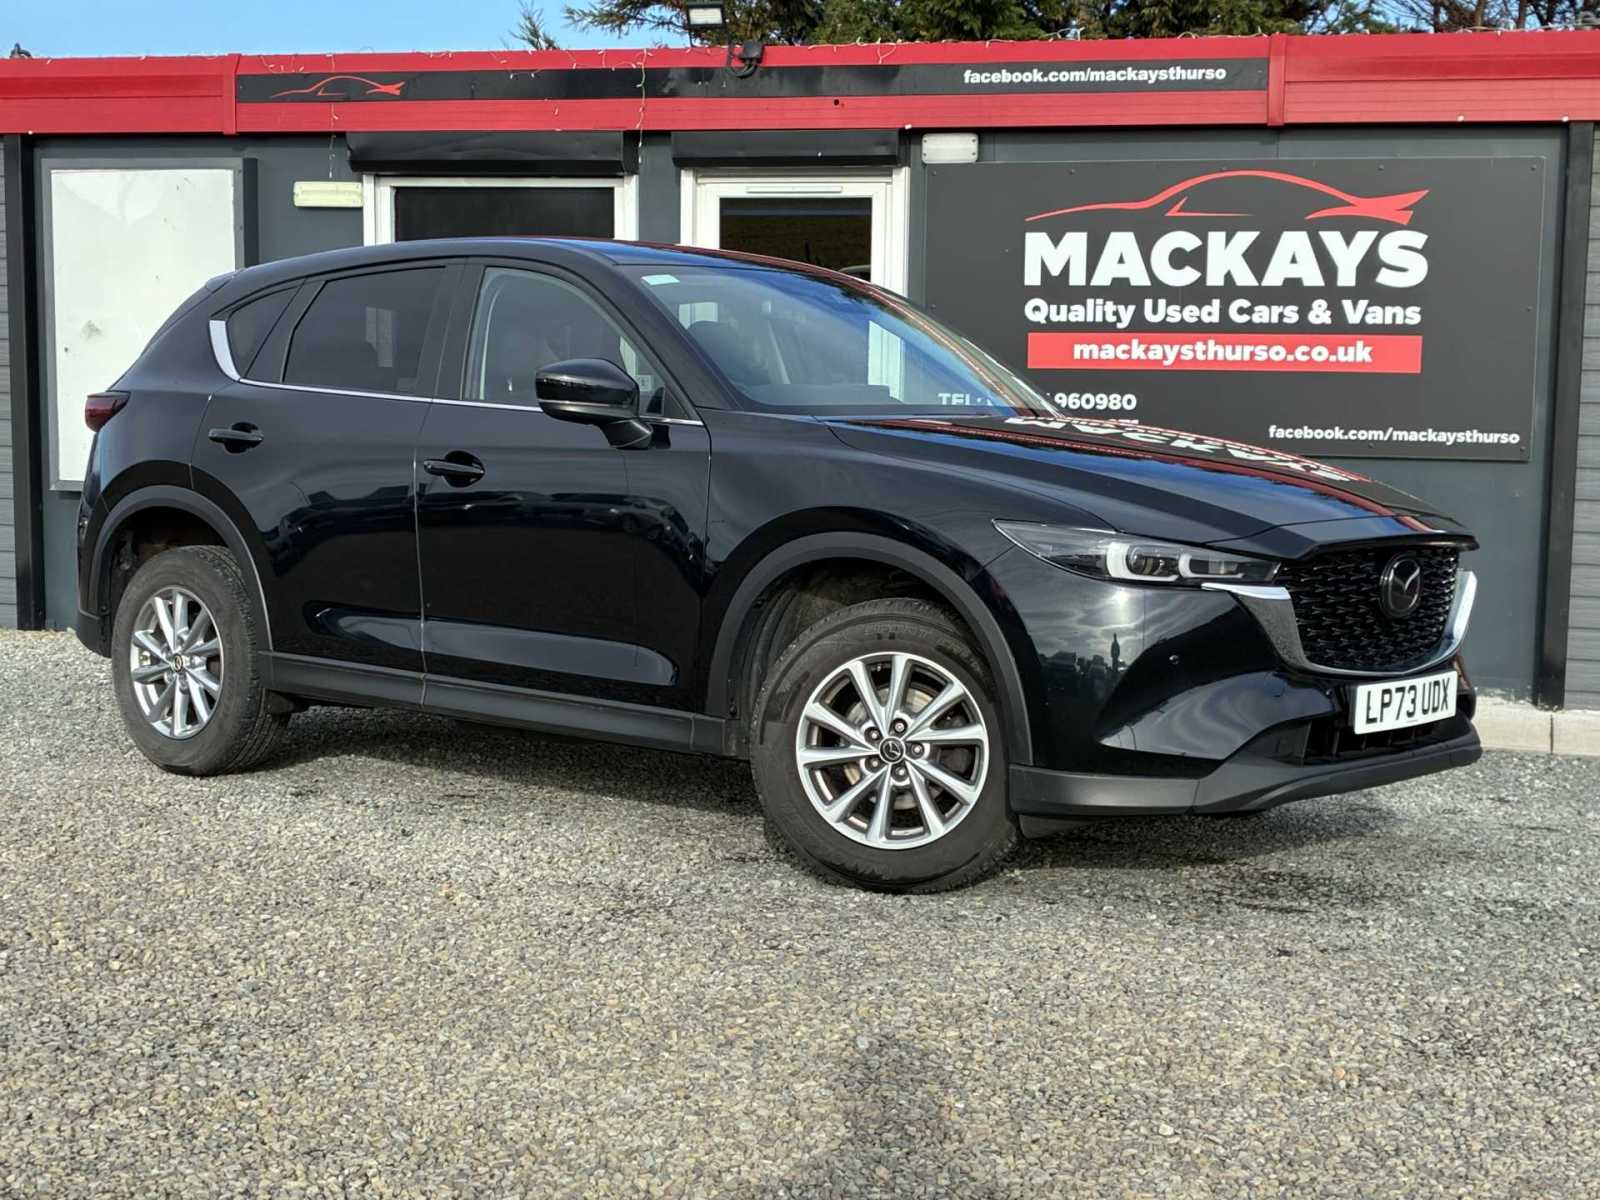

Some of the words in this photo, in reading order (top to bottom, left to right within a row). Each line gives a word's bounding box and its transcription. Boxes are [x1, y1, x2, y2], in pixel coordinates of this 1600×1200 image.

[963, 65, 1227, 84] facebook.com/mackaysthurso
[1023, 230, 1429, 288] MACKAYS
[1024, 298, 1137, 329] Quality
[1143, 299, 1219, 324] Used
[1228, 299, 1300, 324] Cars
[1307, 299, 1333, 325] &
[1341, 300, 1422, 325] Vans
[1073, 338, 1373, 366] mackaysthurso.co.uk
[1268, 424, 1520, 445] facebook.com/mackaysthurso
[1366, 685, 1418, 724] LP73
[1421, 677, 1450, 715] UDX
